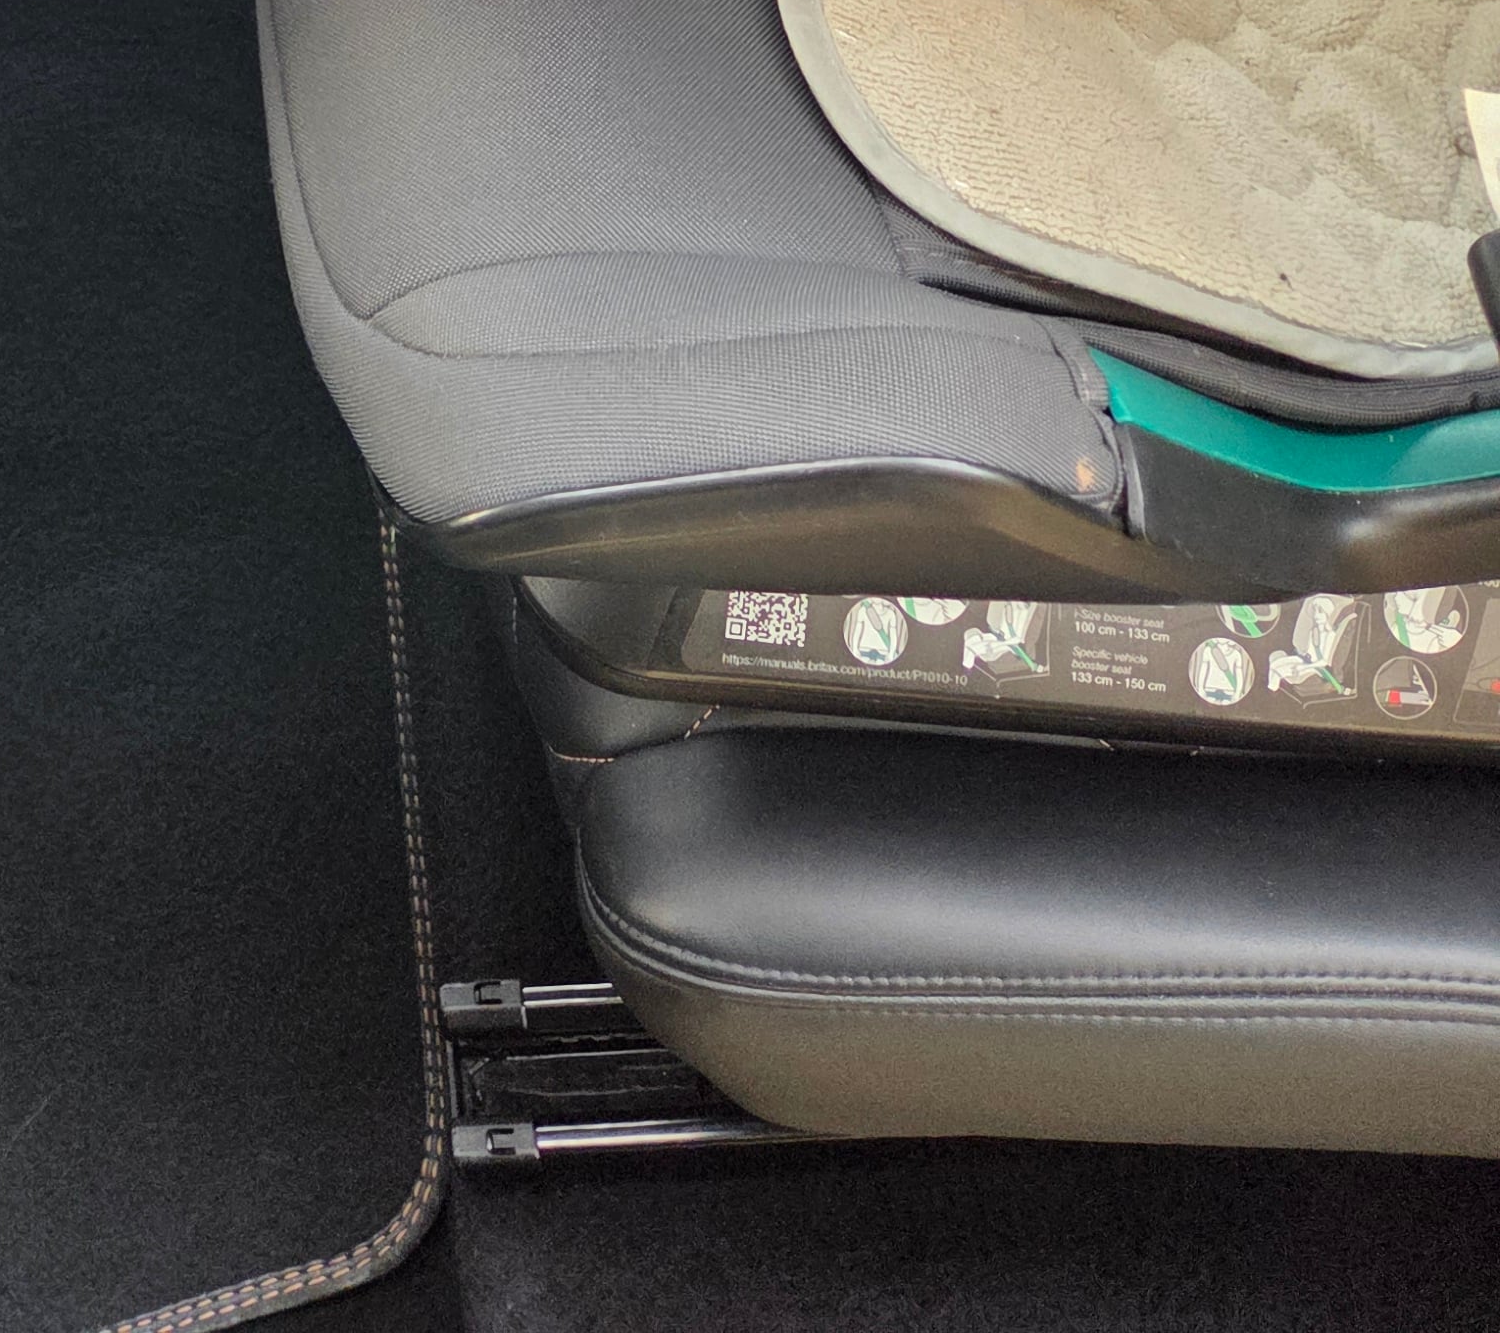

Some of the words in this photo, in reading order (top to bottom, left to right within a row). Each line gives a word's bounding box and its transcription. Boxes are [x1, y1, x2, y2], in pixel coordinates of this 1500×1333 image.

[1075, 621, 1095, 634] 100
[1098, 626, 1116, 636] cm
[1128, 627, 1149, 640] 133
[1151, 632, 1170, 643] cm
[1072, 646, 1112, 660] Specific
[1114, 653, 1148, 665] vehicle
[1071, 671, 1092, 684] 133
[1094, 676, 1113, 687] cm
[1125, 678, 1145, 690] 150
[1147, 682, 1167, 692] cm
